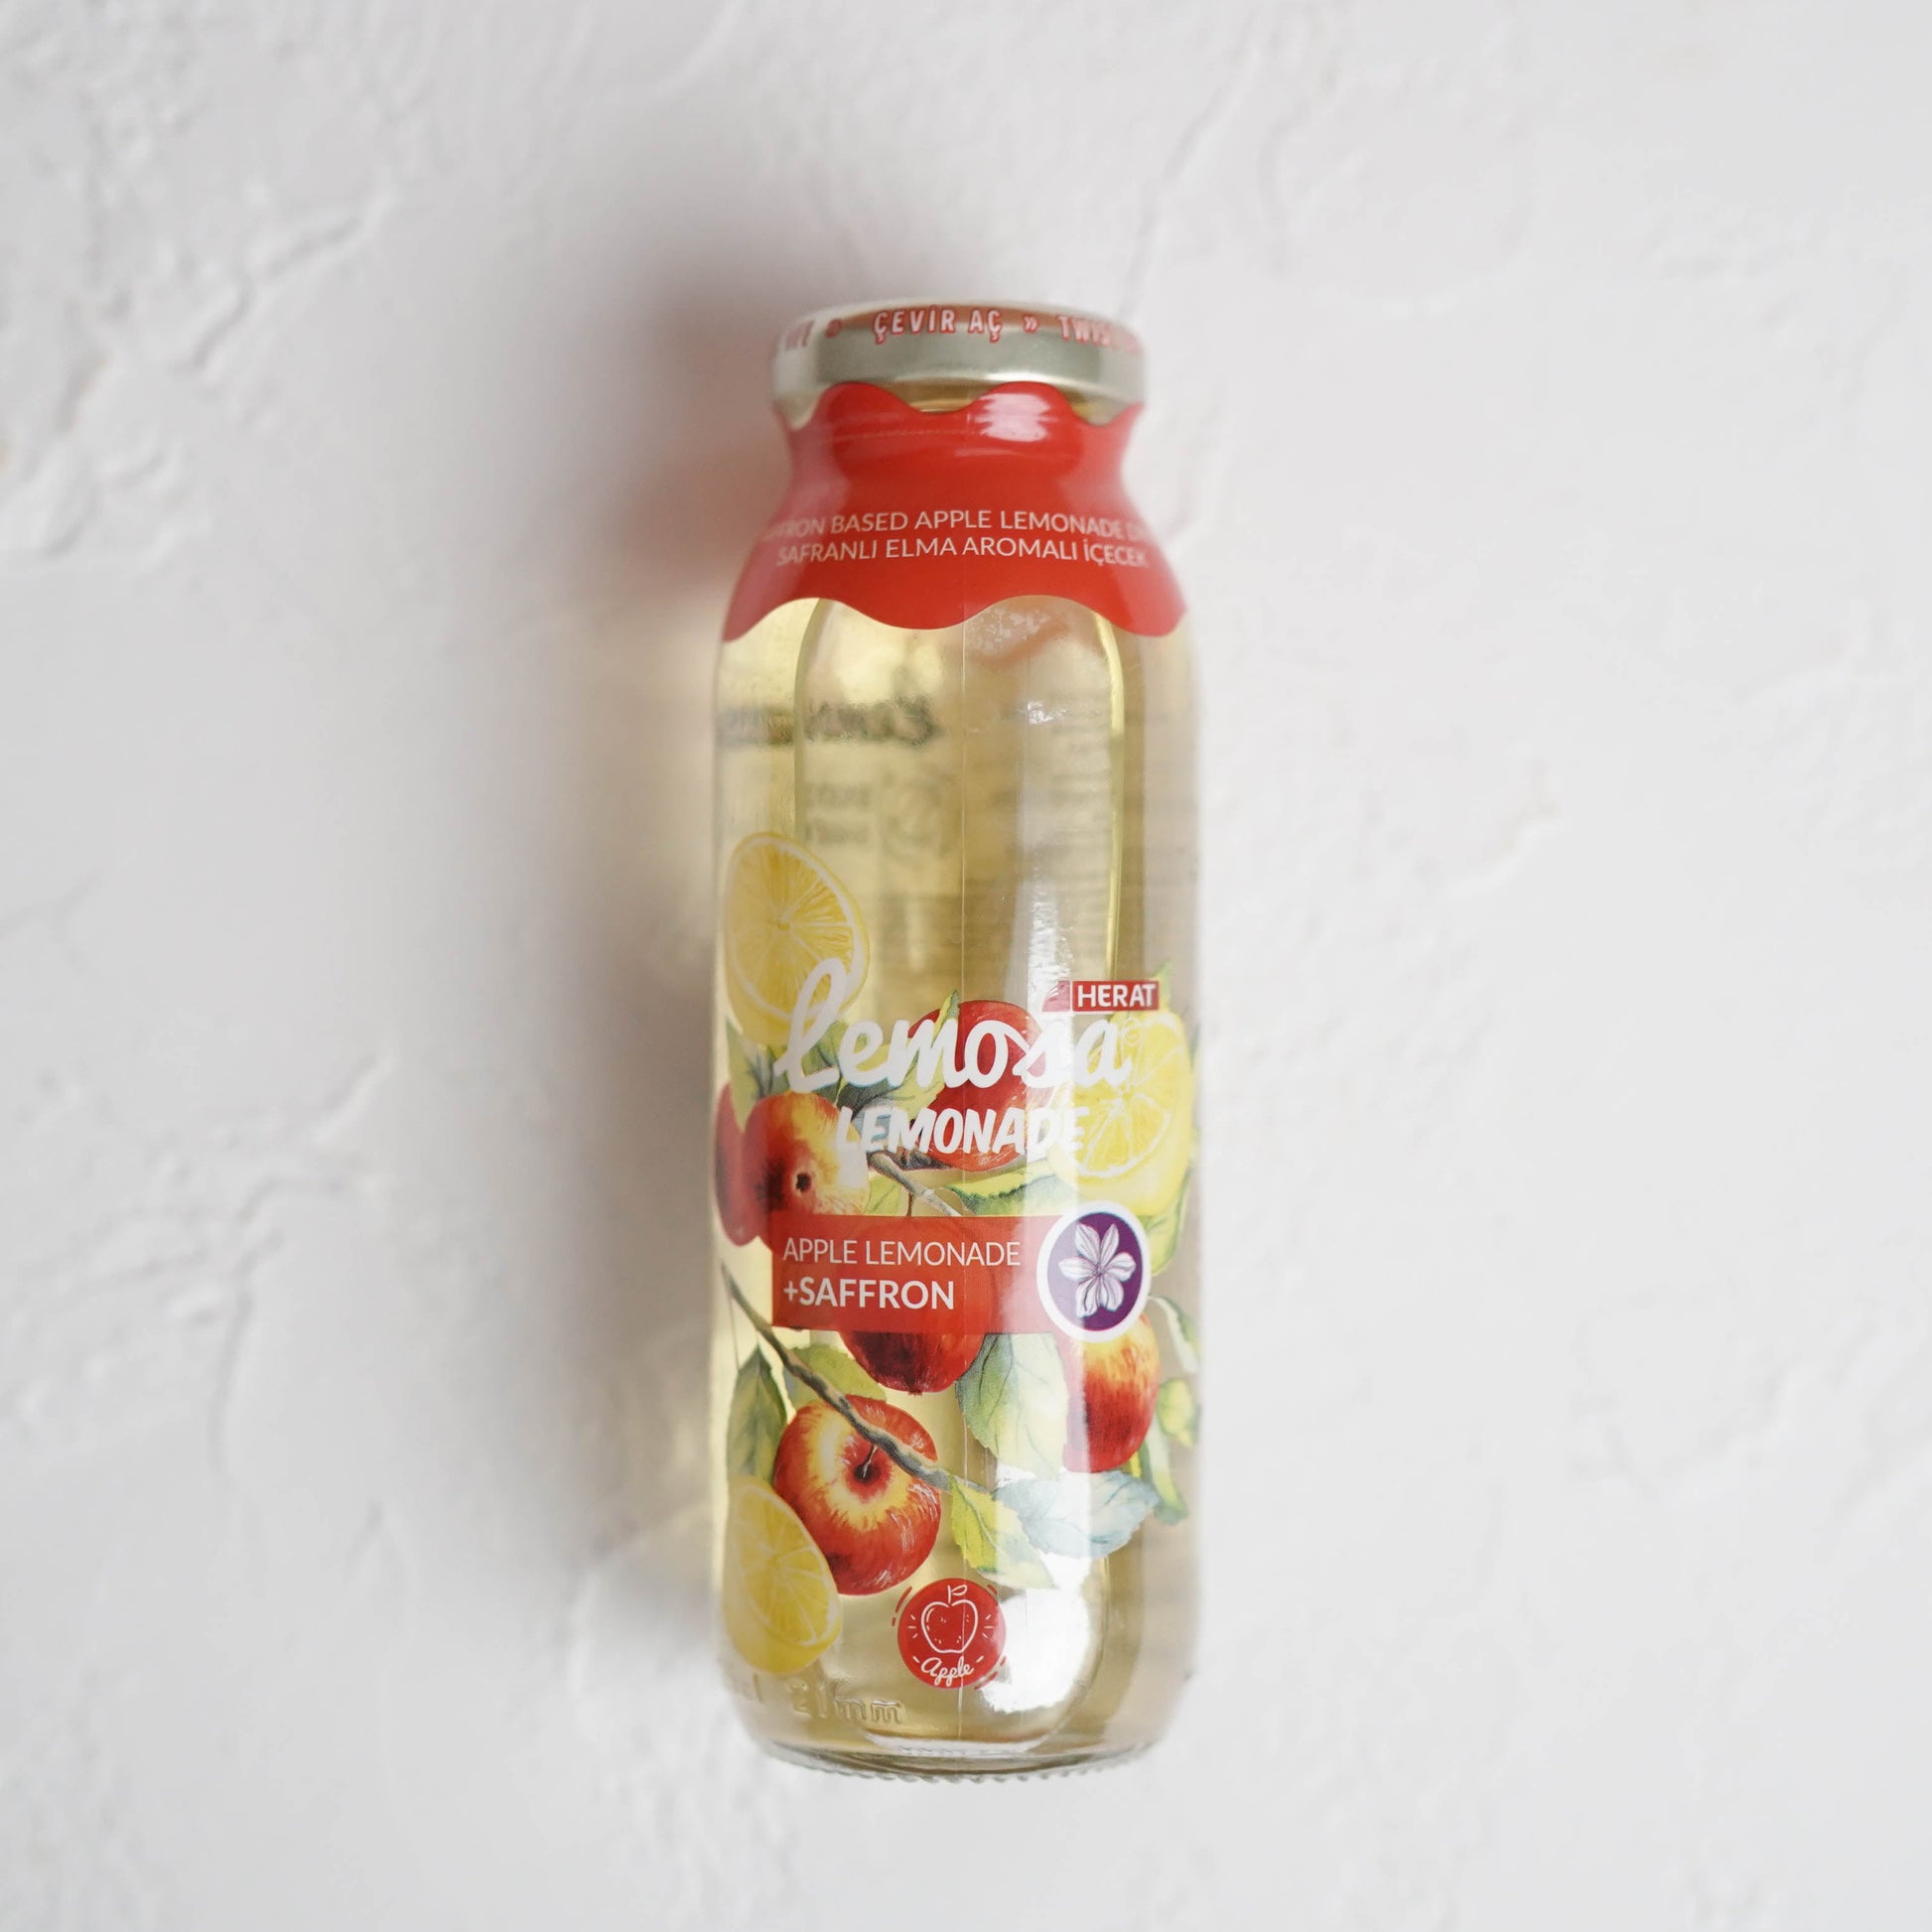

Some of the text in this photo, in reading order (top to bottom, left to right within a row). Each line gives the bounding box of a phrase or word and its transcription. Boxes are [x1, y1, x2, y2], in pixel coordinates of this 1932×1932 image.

[873, 305, 955, 345] ÇEVİR
[967, 309, 1003, 344] AÇ
[831, 511, 908, 534] BASED
[913, 509, 992, 530] APPLE
[1000, 509, 1123, 540] LEMONADE
[776, 536, 1149, 568] SAFRANLI ELMA AROMALI İÇECEK
[1077, 984, 1156, 1008] HERAT
[837, 1105, 1089, 1155] LEMONADE
[782, 1237, 1022, 1267] APPLE LEMONADE
[782, 1277, 955, 1311] +SAFFRON
[921, 1656, 974, 1687] Apple
